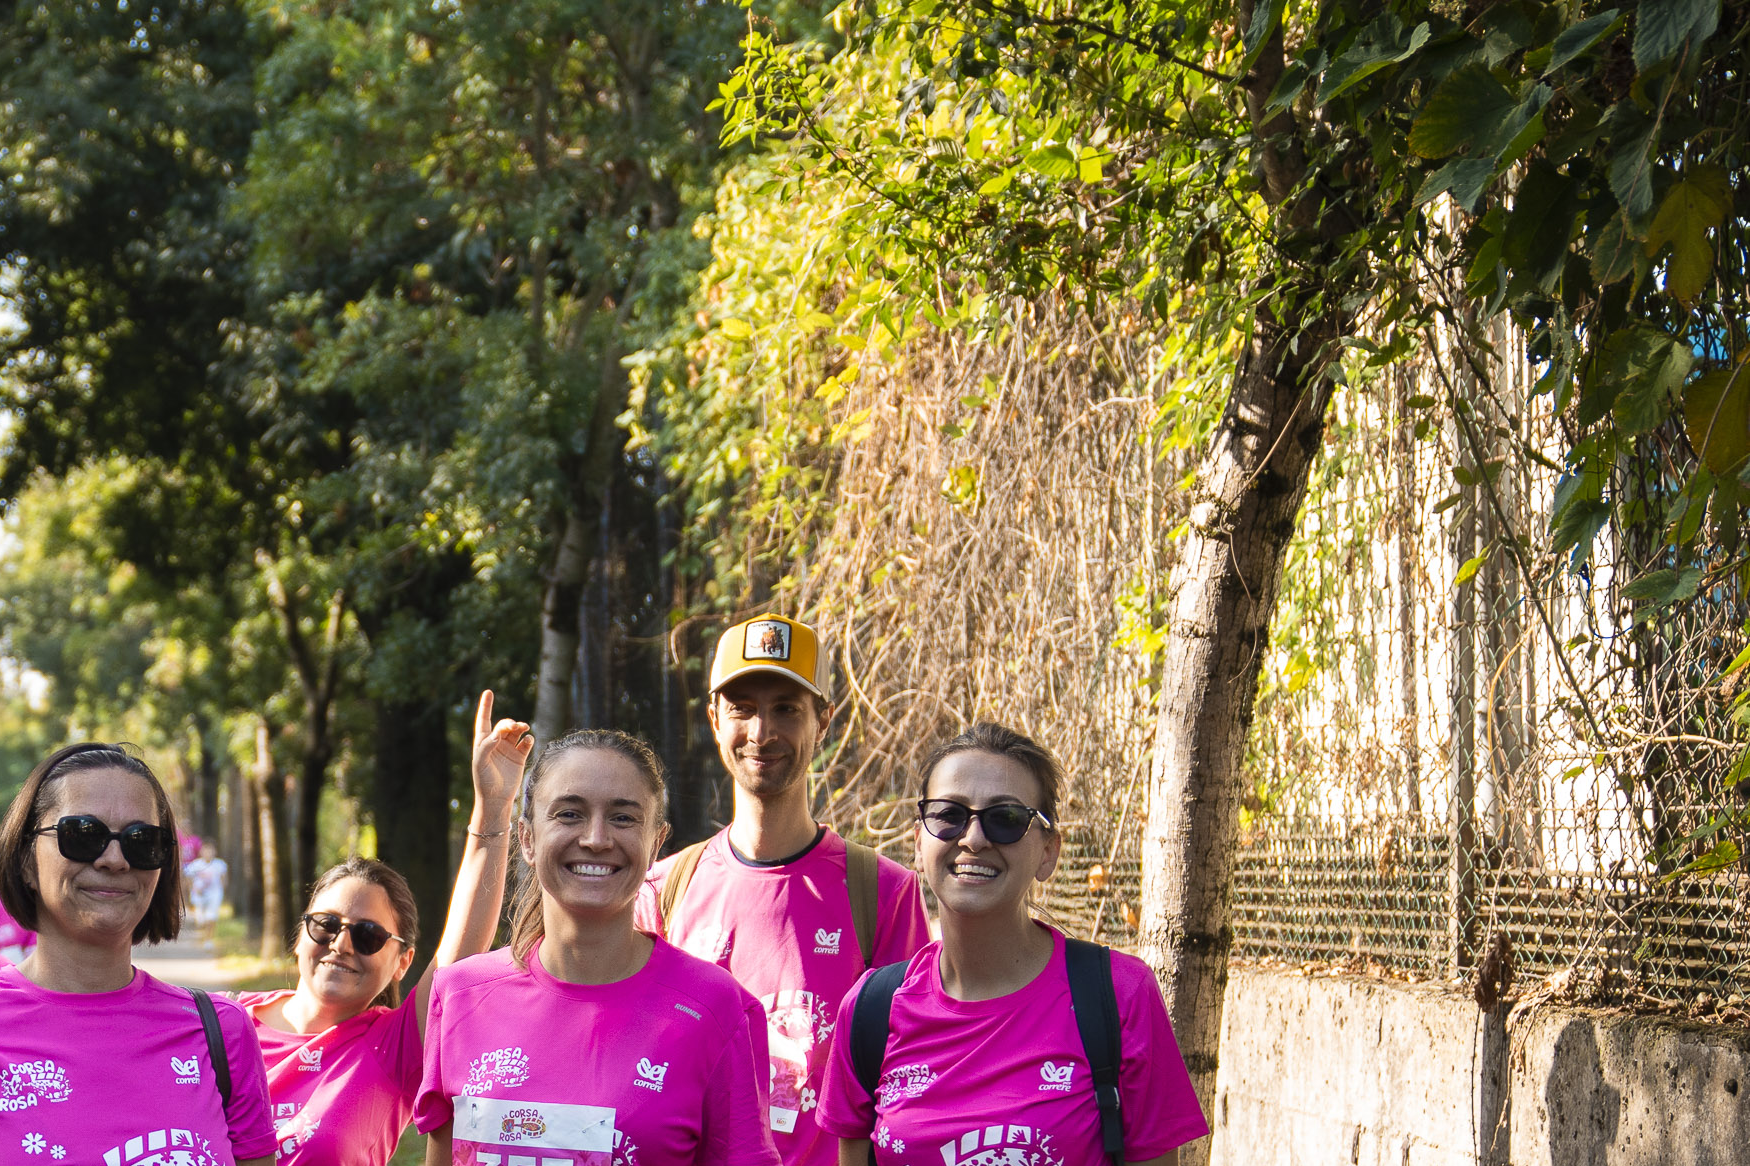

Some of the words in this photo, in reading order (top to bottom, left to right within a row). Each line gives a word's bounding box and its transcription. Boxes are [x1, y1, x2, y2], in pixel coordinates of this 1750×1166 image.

[481, 1046, 522, 1064] CORSA
[9, 1059, 55, 1075] CORSA
[890, 1064, 929, 1079] CORSA
[461, 1079, 493, 1097] ROSA
[633, 1079, 663, 1093] correre
[1038, 1084, 1072, 1092] correre
[509, 1108, 539, 1119] CORSA
[499, 1132, 522, 1142] ROSA
